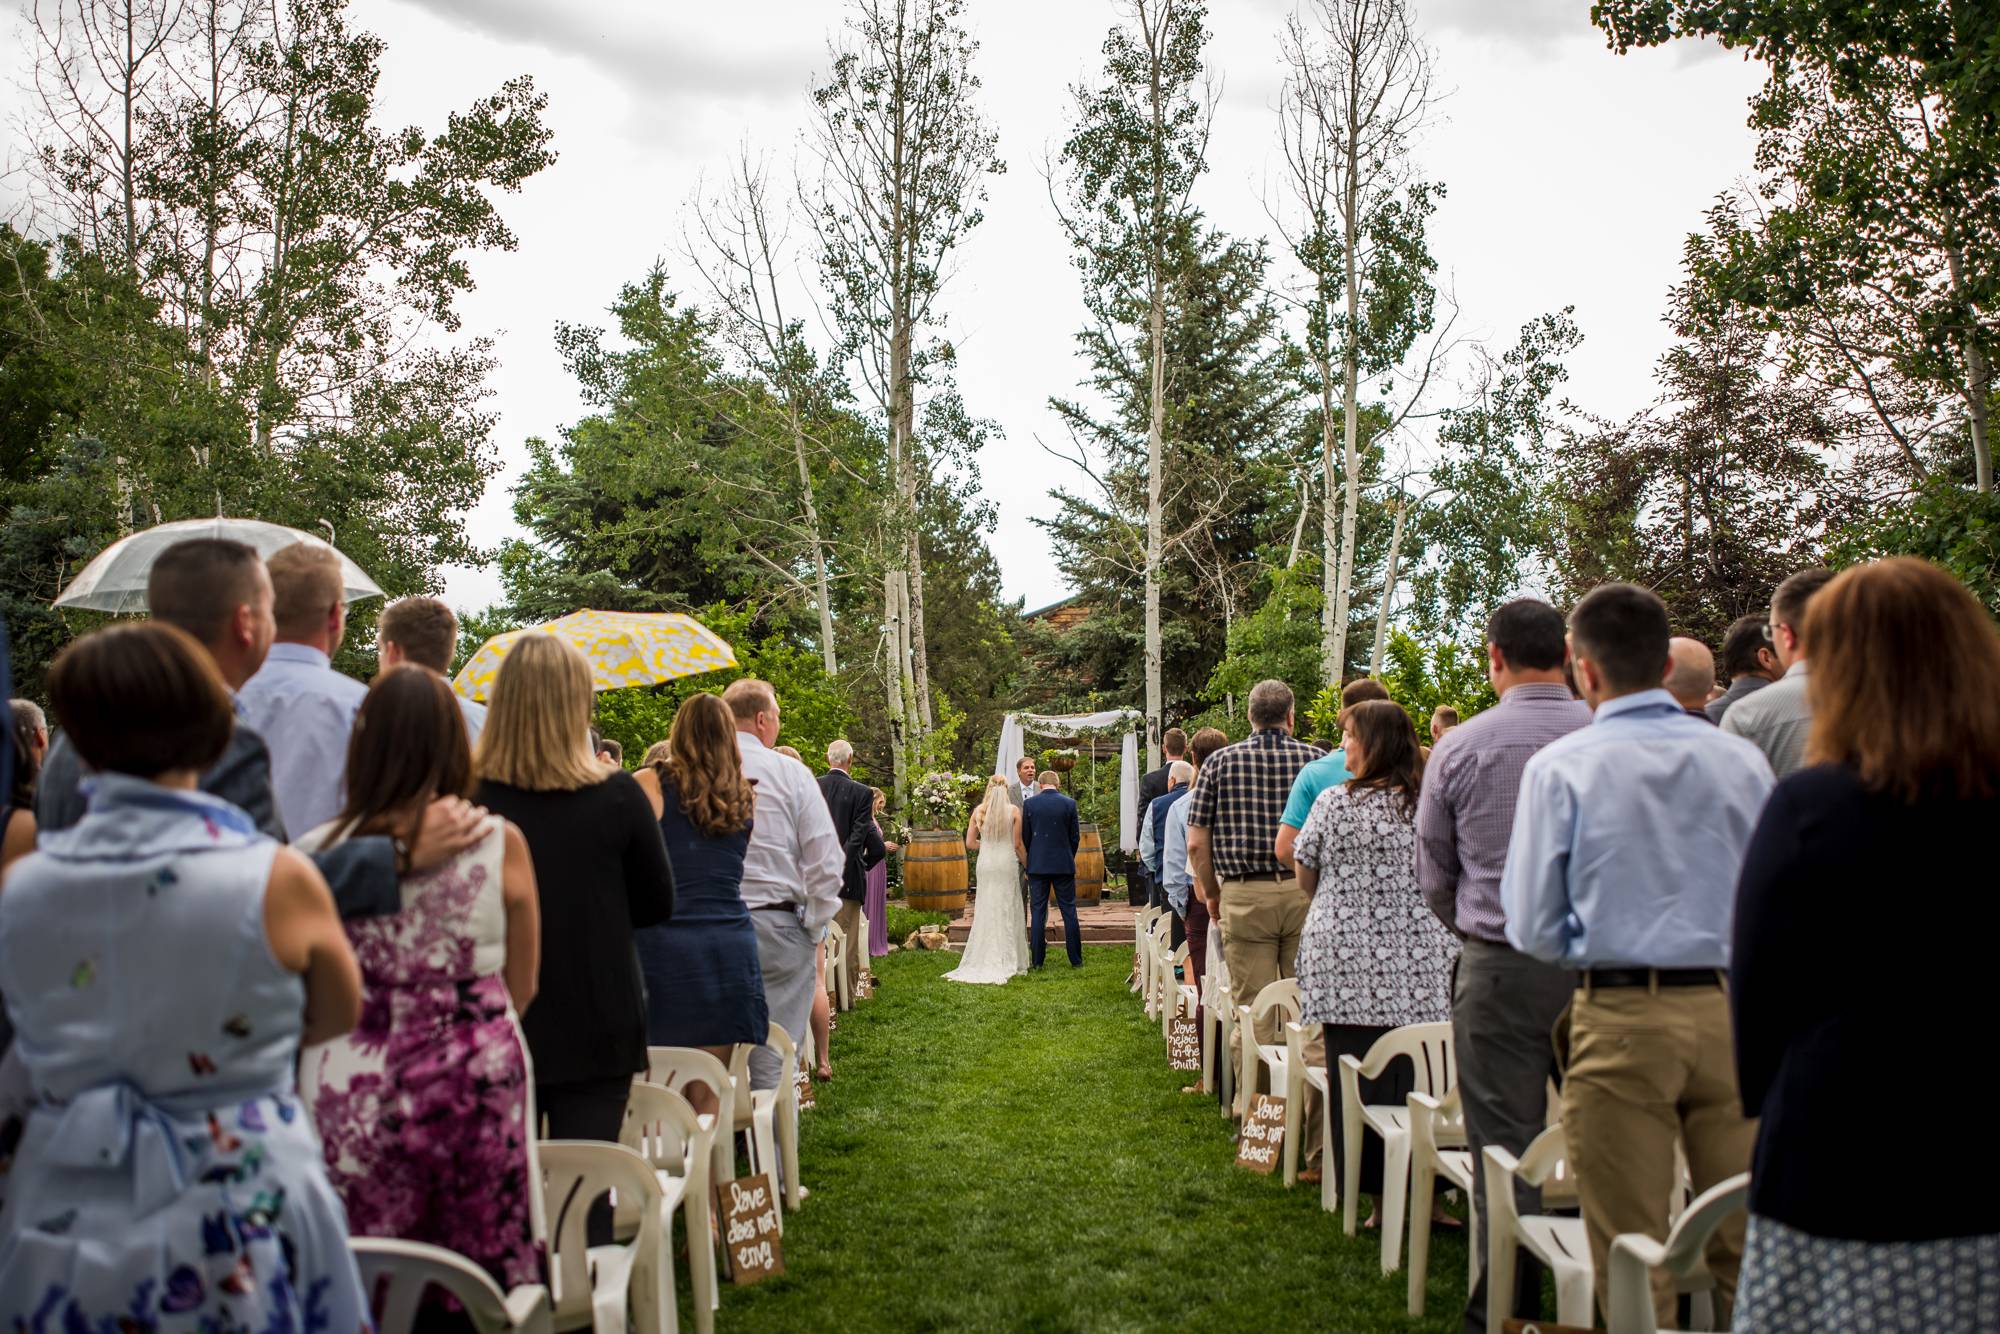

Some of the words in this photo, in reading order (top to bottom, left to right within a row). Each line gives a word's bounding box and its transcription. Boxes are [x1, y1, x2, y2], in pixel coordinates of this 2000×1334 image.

[1172, 1045, 1182, 1057] in
[1182, 1044, 1200, 1057] the
[1169, 1058, 1200, 1070] truth
[1242, 1117, 1266, 1140] does
[1239, 1139, 1275, 1164] boast
[727, 1218, 756, 1245] does
[756, 1208, 777, 1235] not
[737, 1241, 775, 1270] envy
